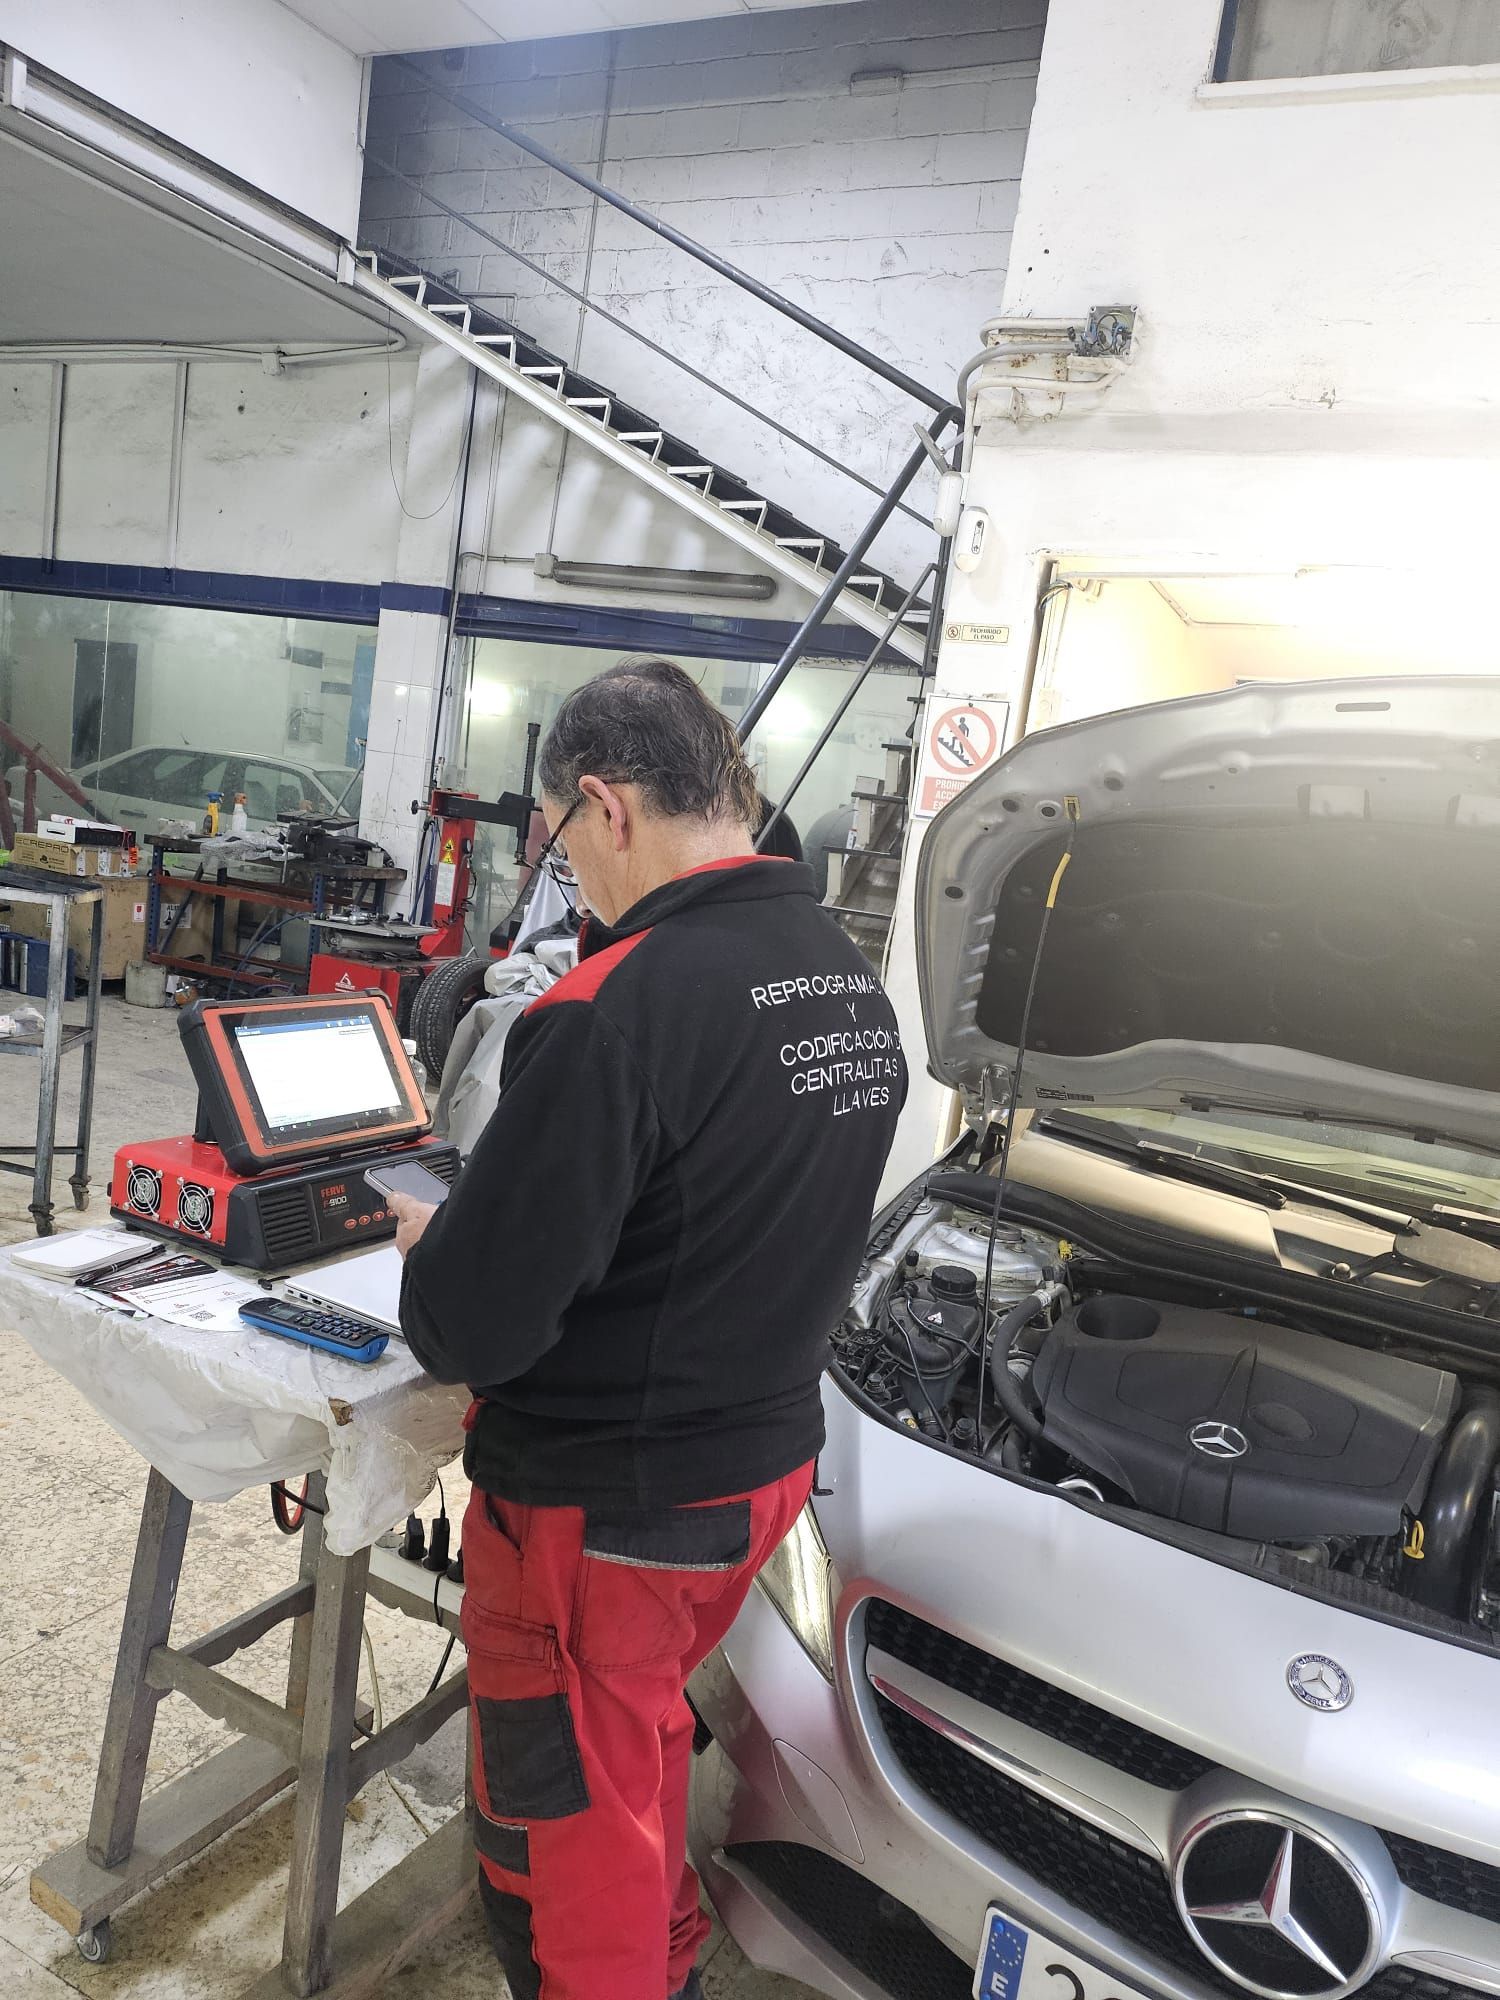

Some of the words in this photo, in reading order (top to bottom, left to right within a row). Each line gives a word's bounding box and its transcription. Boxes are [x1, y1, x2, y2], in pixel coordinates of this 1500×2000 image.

[846, 1002, 857, 1022] Y
[780, 1026, 893, 1066] CODIFICACIÓN
[791, 1058, 898, 1095] CENTRALITAS
[833, 1086, 890, 1116] LLAVES
[321, 1184, 346, 1198] FERVE
[991, 1971, 1009, 1998] E
